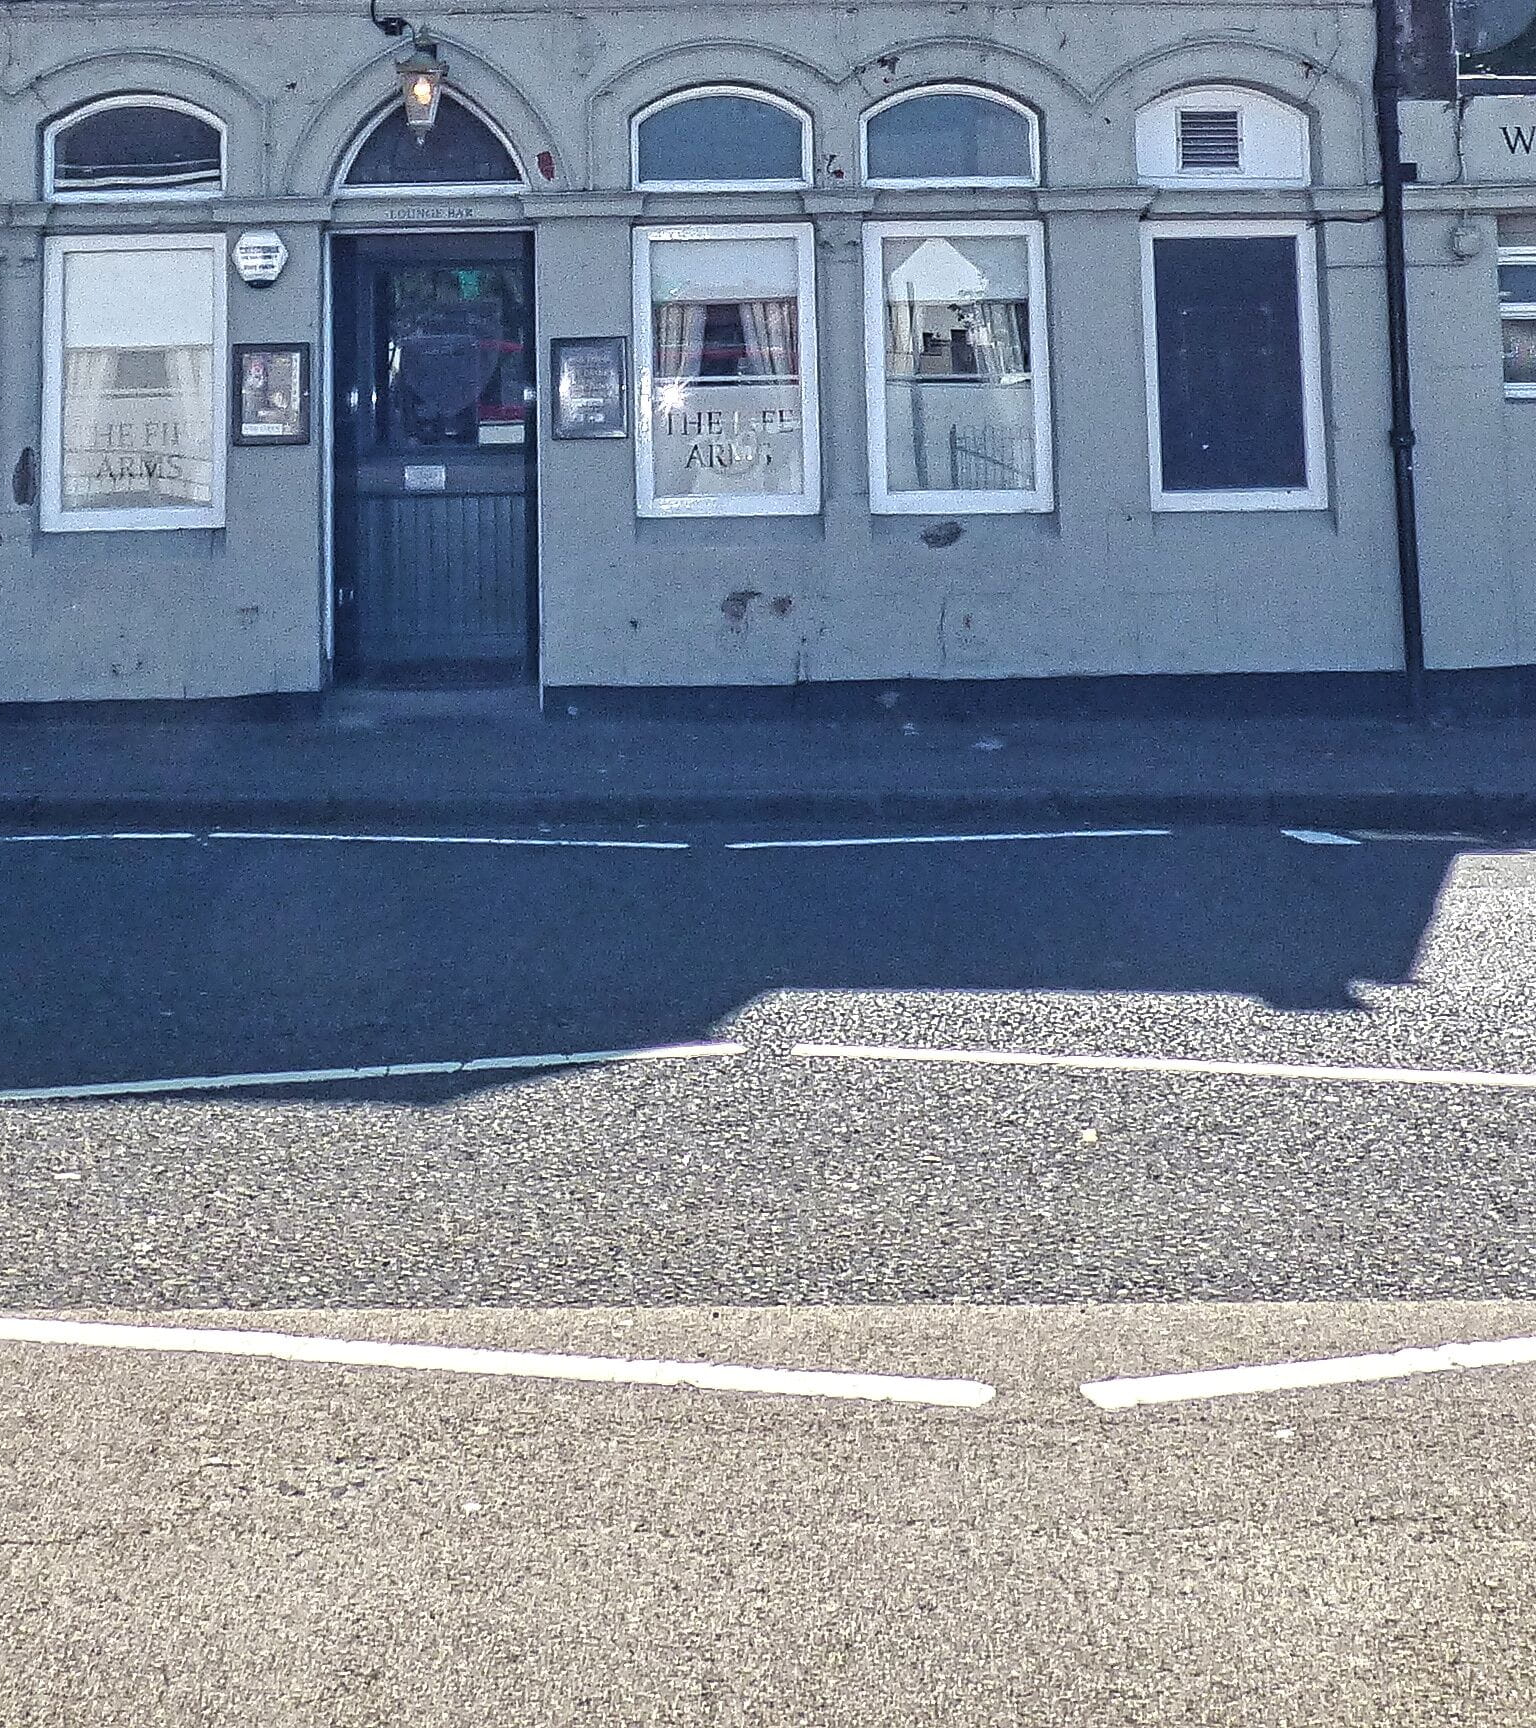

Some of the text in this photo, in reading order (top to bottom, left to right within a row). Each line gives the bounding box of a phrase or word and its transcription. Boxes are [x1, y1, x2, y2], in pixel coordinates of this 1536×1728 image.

[91, 422, 136, 448] HE
[667, 410, 795, 436] THE FE
